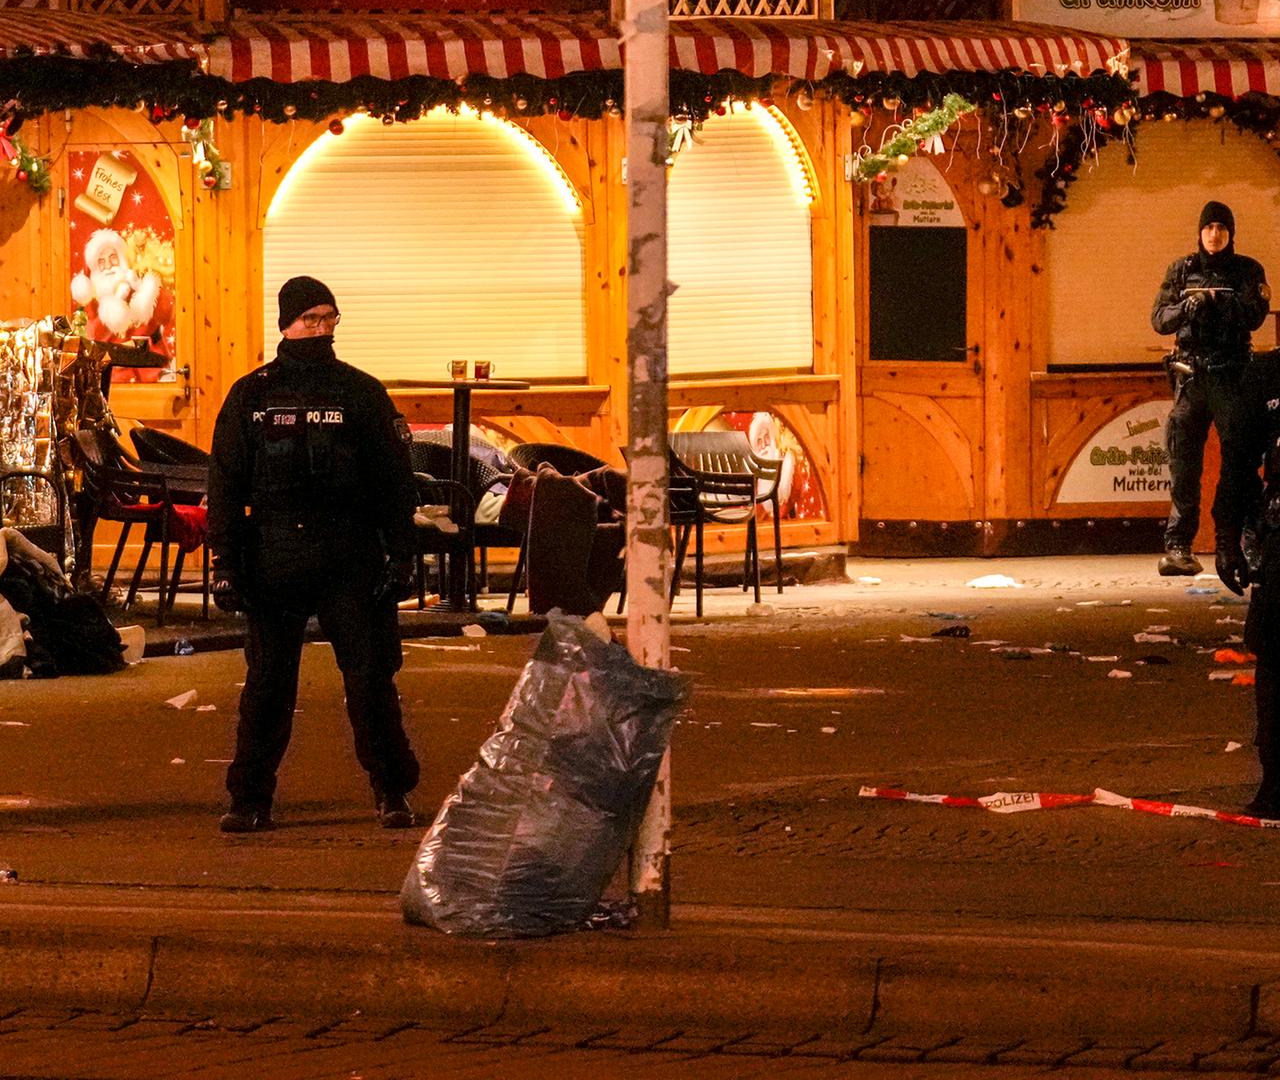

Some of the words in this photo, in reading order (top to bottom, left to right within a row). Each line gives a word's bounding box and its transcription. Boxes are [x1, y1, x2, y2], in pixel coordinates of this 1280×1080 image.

[94, 167, 124, 193] Frohes
[93, 184, 113, 203] Fest
[1113, 476, 1173, 492] Muttern
[985, 792, 1035, 808] POLIZEI
